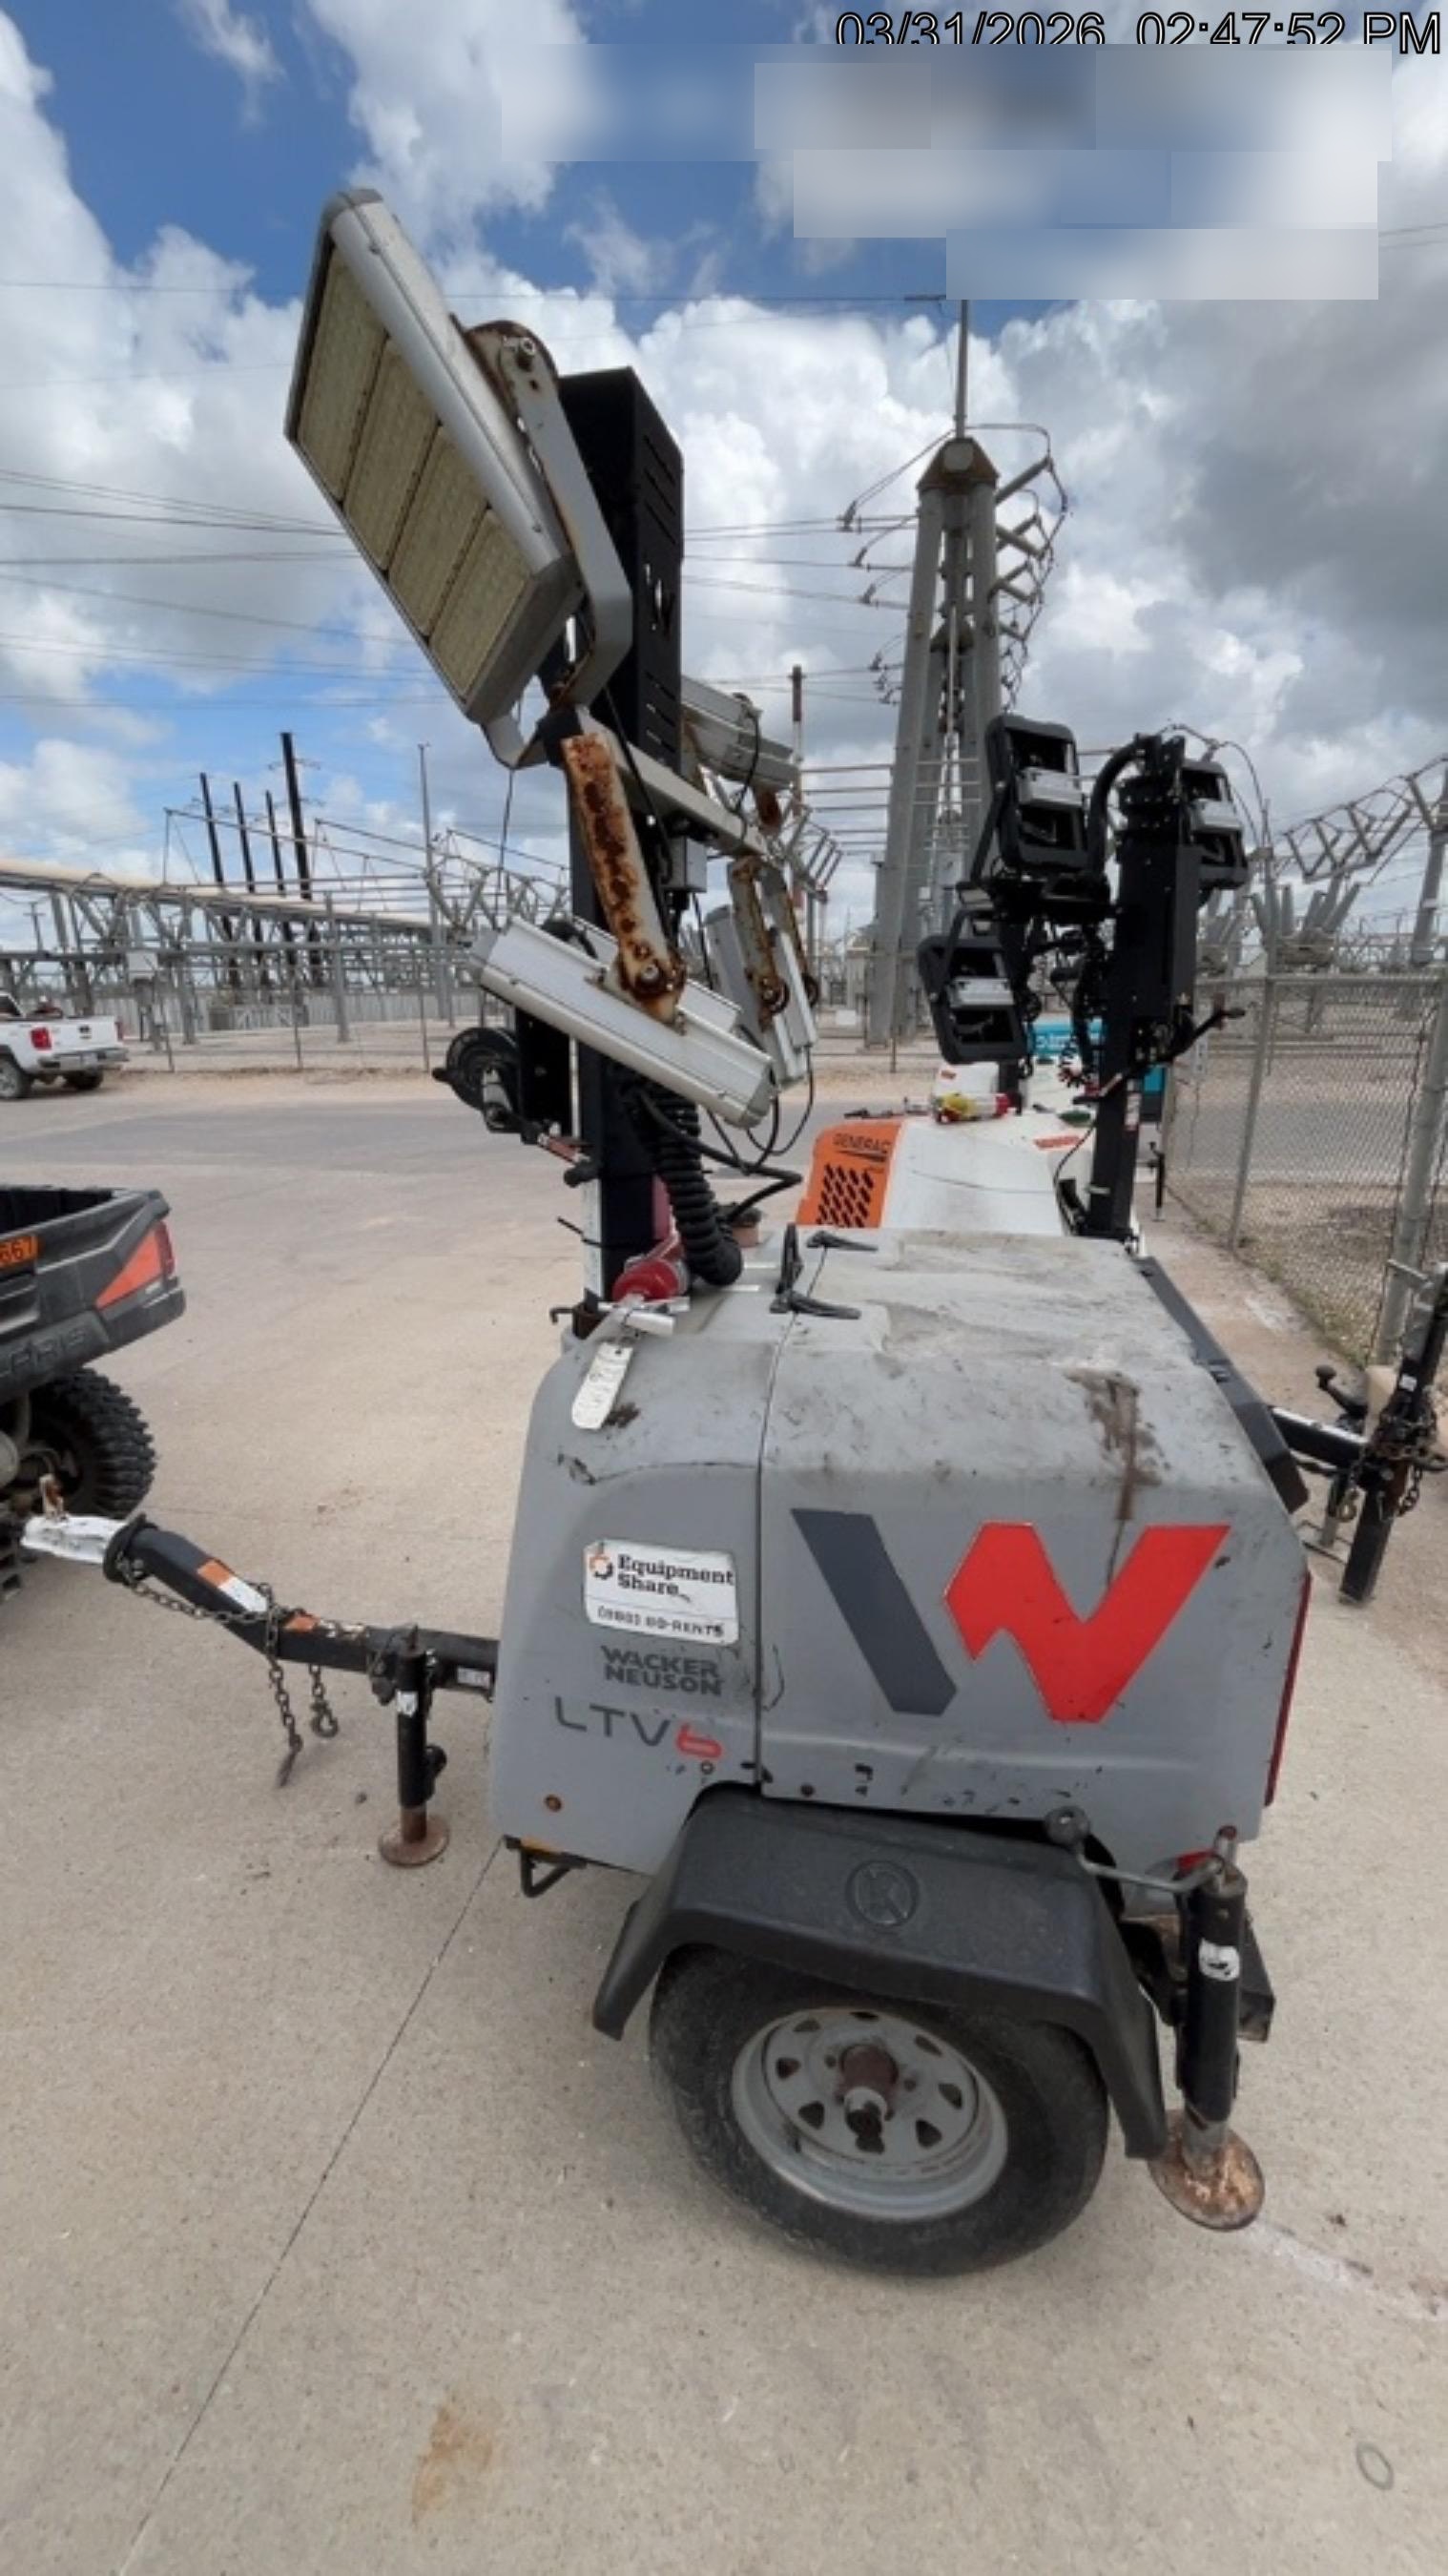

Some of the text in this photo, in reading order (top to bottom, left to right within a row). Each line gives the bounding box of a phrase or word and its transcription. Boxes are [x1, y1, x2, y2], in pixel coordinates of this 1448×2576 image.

[618, 1553, 734, 1586] Equipment
[618, 1574, 679, 1595] Share
[601, 1645, 719, 1678] WACKER
[605, 1664, 721, 1695] NEUSON
[555, 1695, 722, 1759] LTV6
